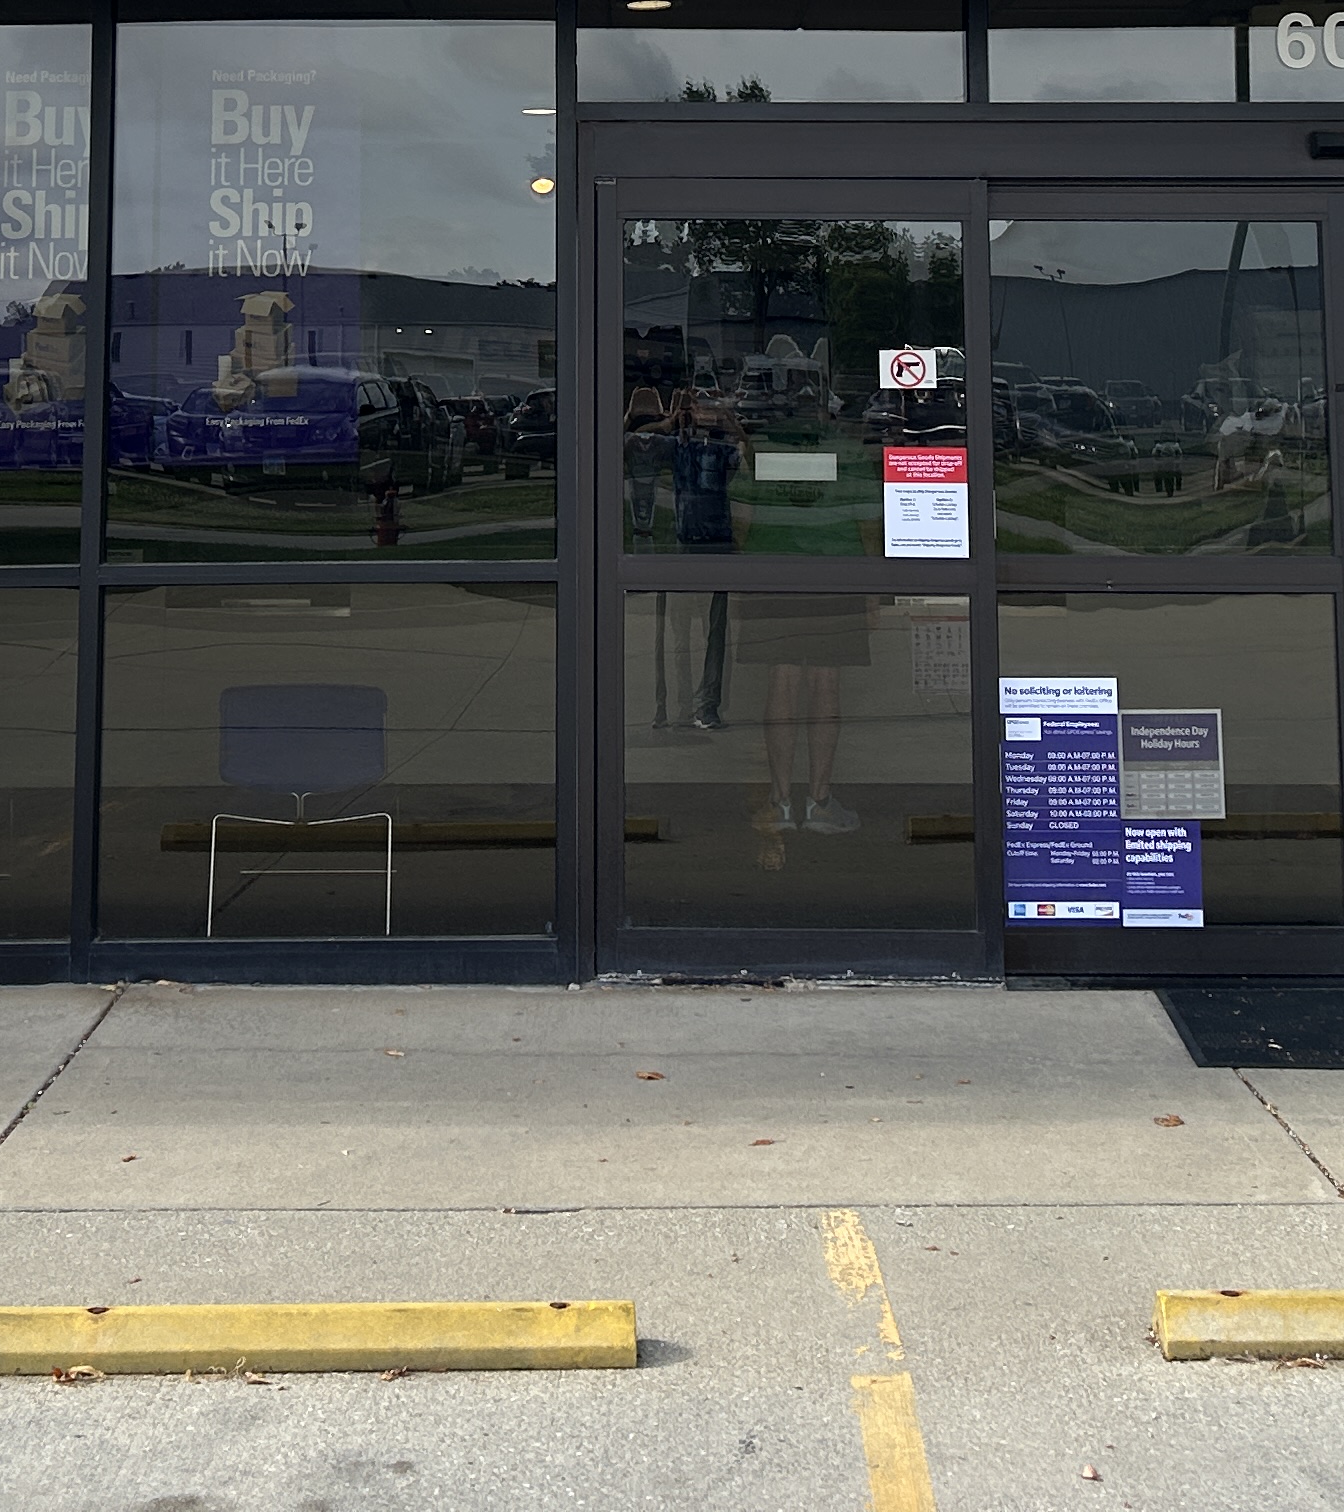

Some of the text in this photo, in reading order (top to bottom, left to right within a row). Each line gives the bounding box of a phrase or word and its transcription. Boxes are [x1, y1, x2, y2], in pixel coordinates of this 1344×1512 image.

[6, 70, 37, 83] Need
[212, 69, 317, 85] Need Packaging?
[211, 88, 316, 156] Buy
[3, 147, 90, 188] it Her
[210, 147, 315, 187] it Here
[209, 188, 314, 249] Ship
[0, 241, 20, 280] it
[208, 238, 312, 278] it Now
[1004, 686, 1017, 695] No
[1020, 686, 1060, 697] soliciting
[1074, 686, 1113, 697] loitering
[1130, 726, 1209, 738] Independence Day
[1140, 739, 1200, 750] Holiday Hours
[1005, 752, 1034, 760] Monday
[1005, 763, 1035, 772] Tuesday
[1005, 775, 1047, 784] Wednesday
[1005, 787, 1039, 795] Thursday
[1006, 798, 1029, 807] Friday
[1006, 810, 1038, 819] Saturday
[1006, 822, 1034, 831] Sunday
[1125, 827, 1187, 839] Now open with
[1125, 840, 1192, 852] limited shipping
[1125, 852, 1173, 865] capabilities
